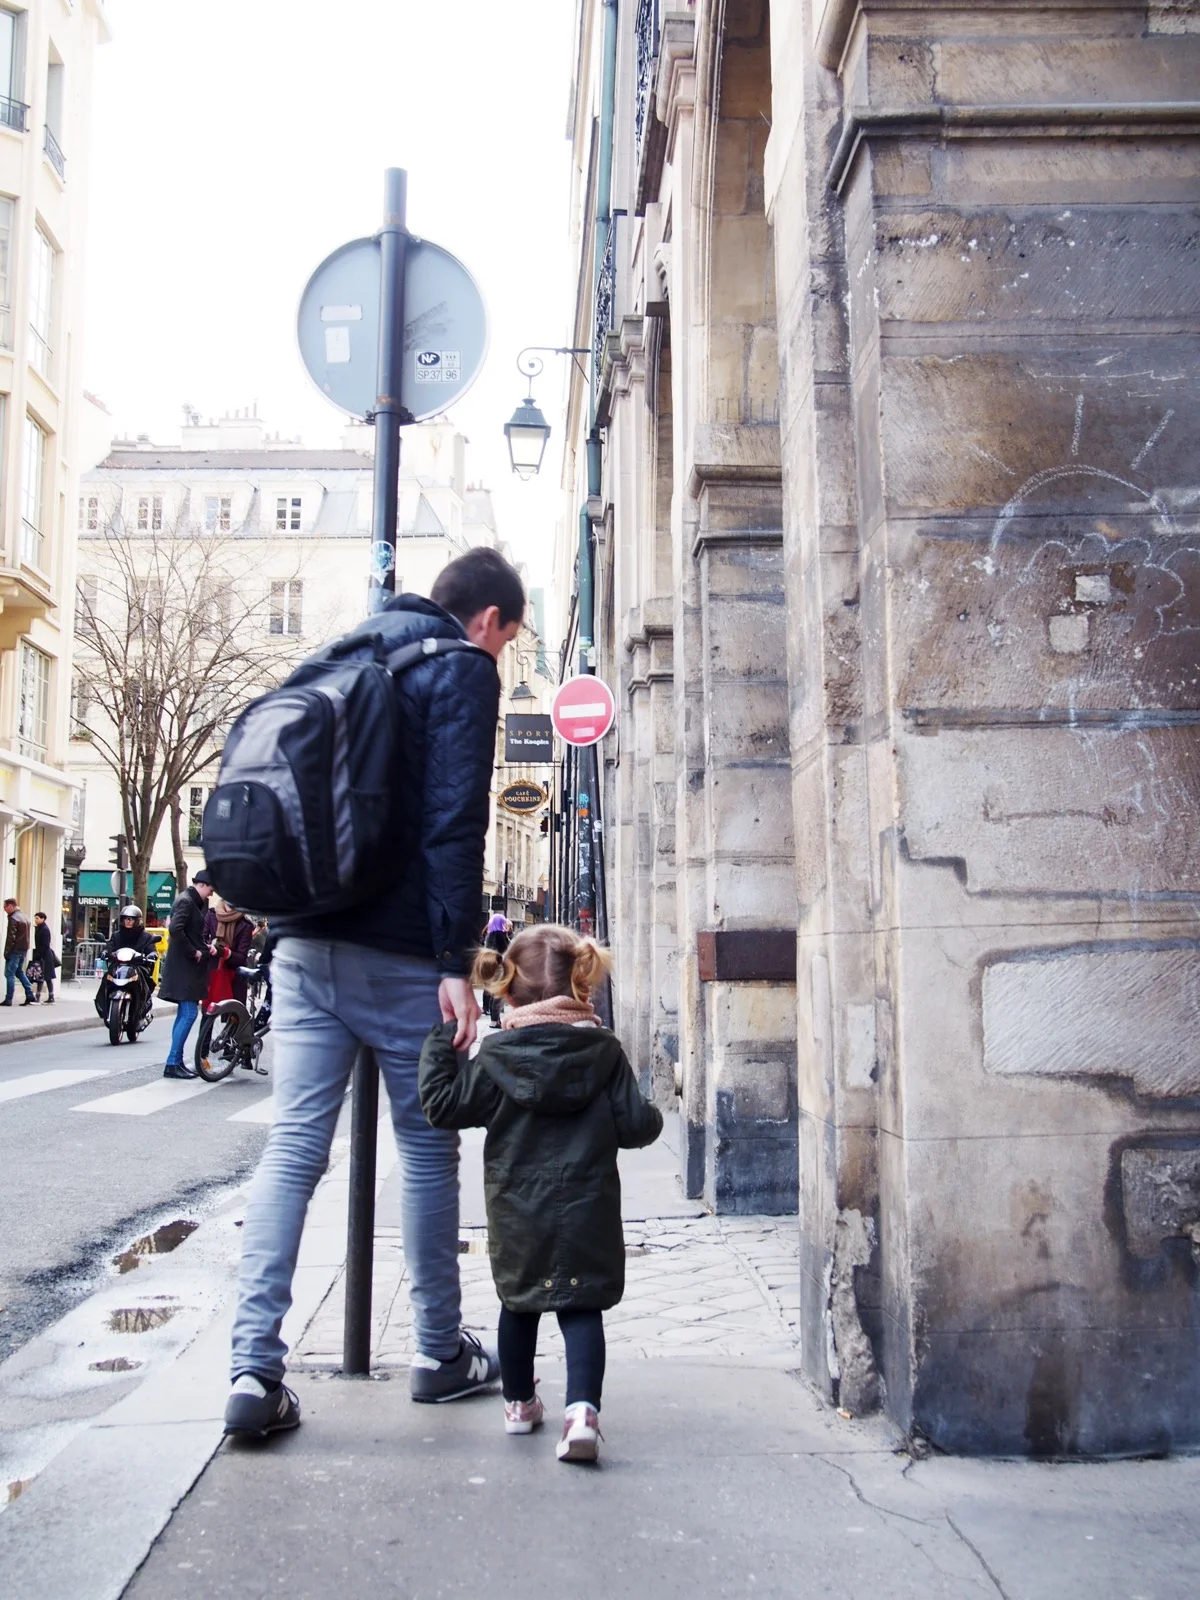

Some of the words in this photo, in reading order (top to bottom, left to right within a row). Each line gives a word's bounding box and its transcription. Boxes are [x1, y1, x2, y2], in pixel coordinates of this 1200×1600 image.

[421, 353, 438, 364] NF
[418, 370, 441, 380] SP.37
[446, 370, 457, 380] 96
[467, 1355, 488, 1381] N
